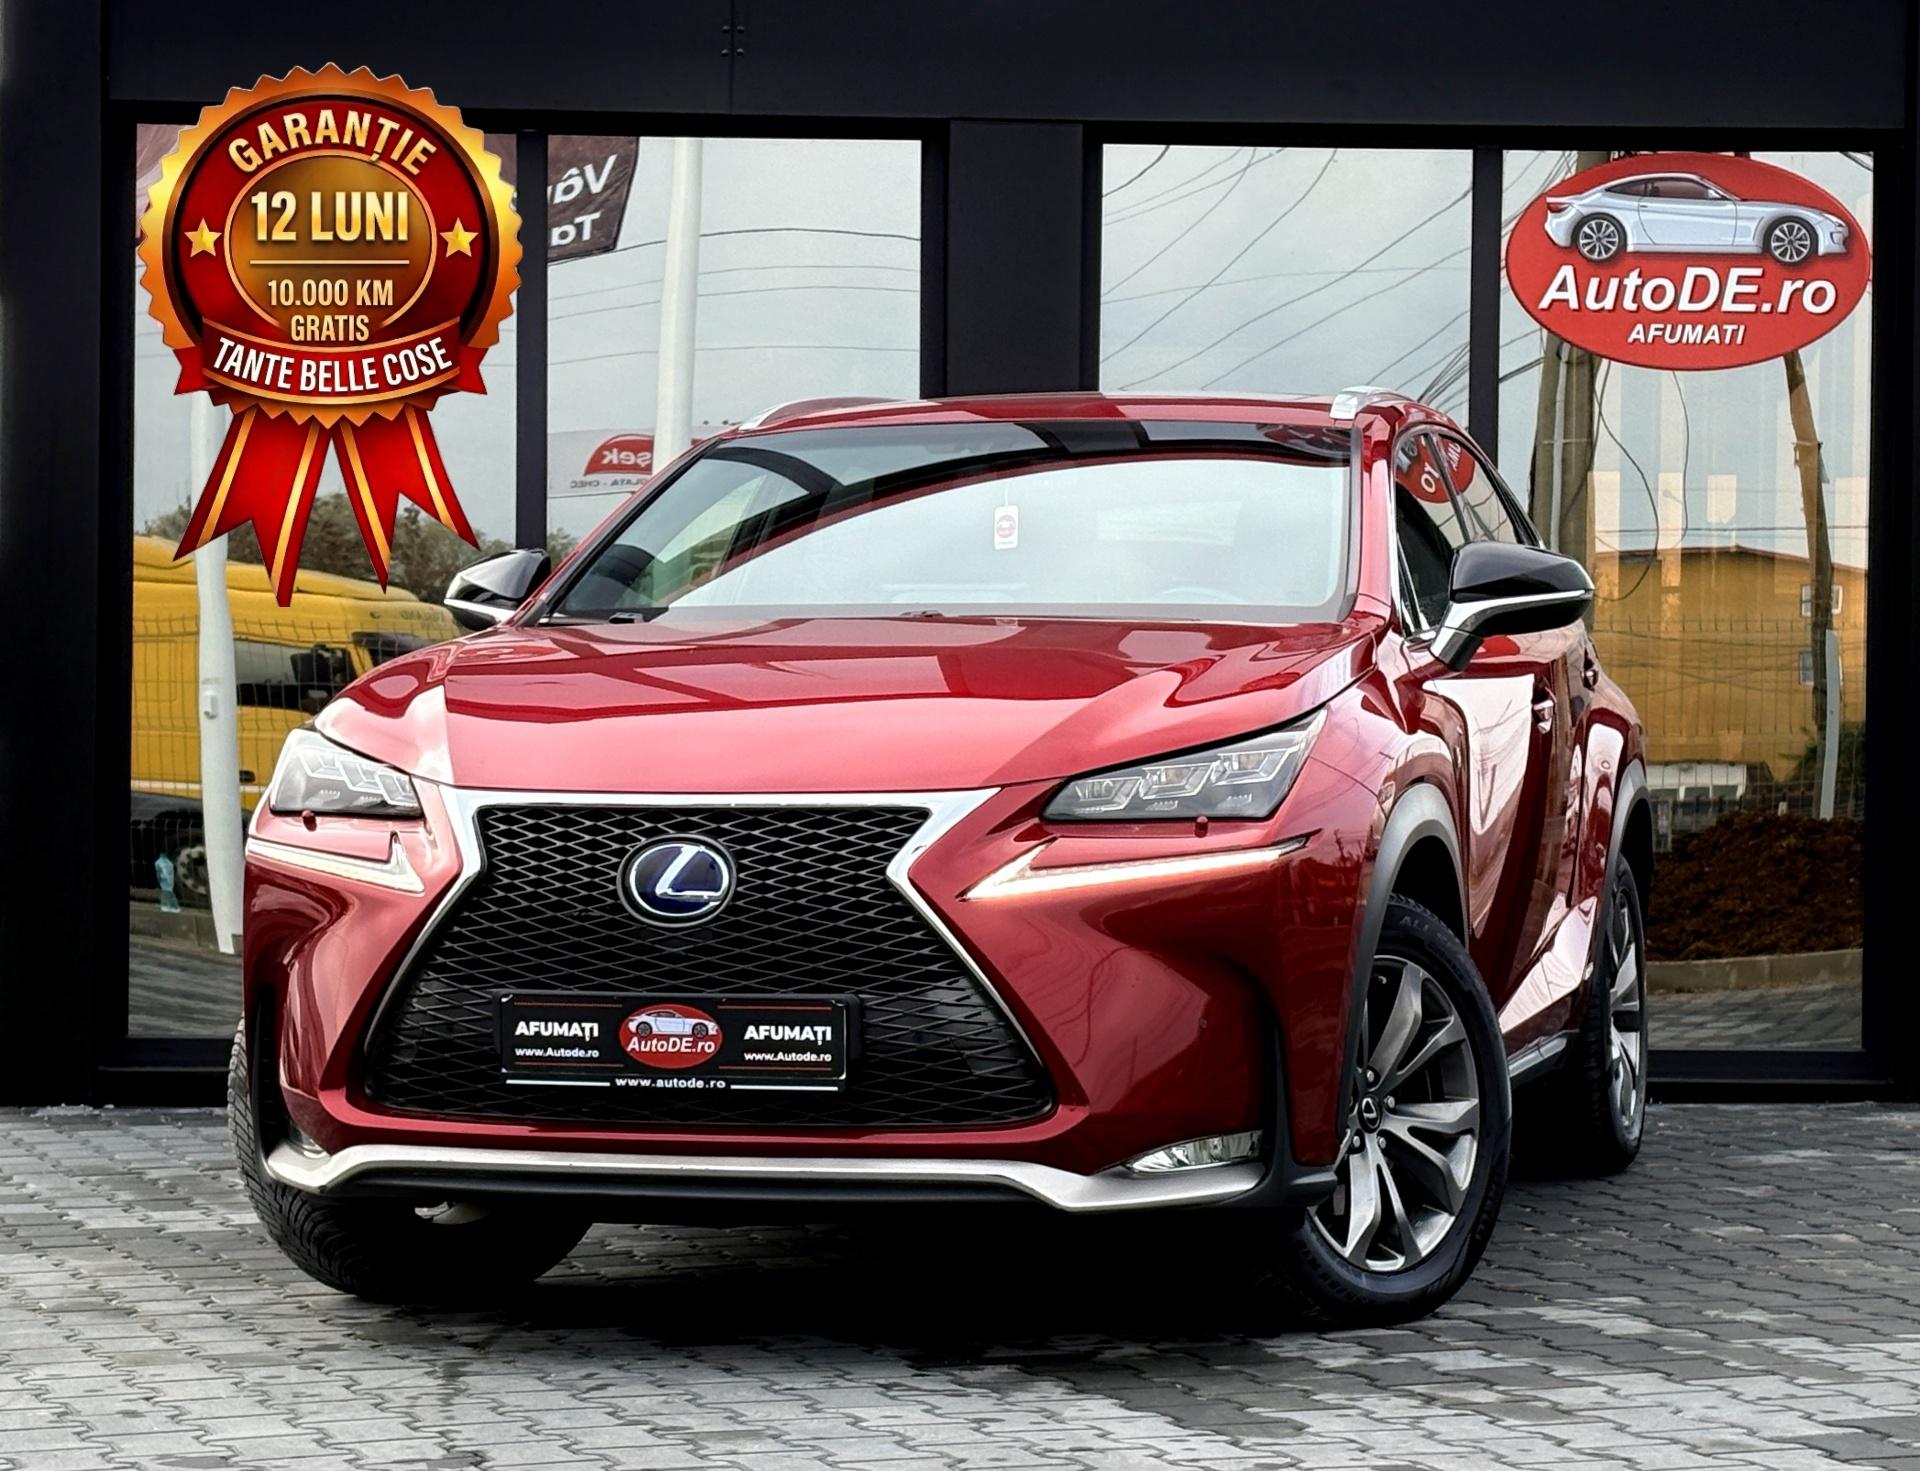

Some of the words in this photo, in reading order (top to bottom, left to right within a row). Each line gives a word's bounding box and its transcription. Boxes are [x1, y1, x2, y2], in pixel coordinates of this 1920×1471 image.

[1537, 264, 1837, 314] AutoDE.ro
[1627, 322, 1746, 345] AFUMATI
[626, 1036, 715, 1053] AutoDE.ro
[515, 1047, 599, 1059] www.Autode.ro
[744, 1051, 832, 1062] www.Autode.ro
[615, 1076, 726, 1089] www.autode.ro
